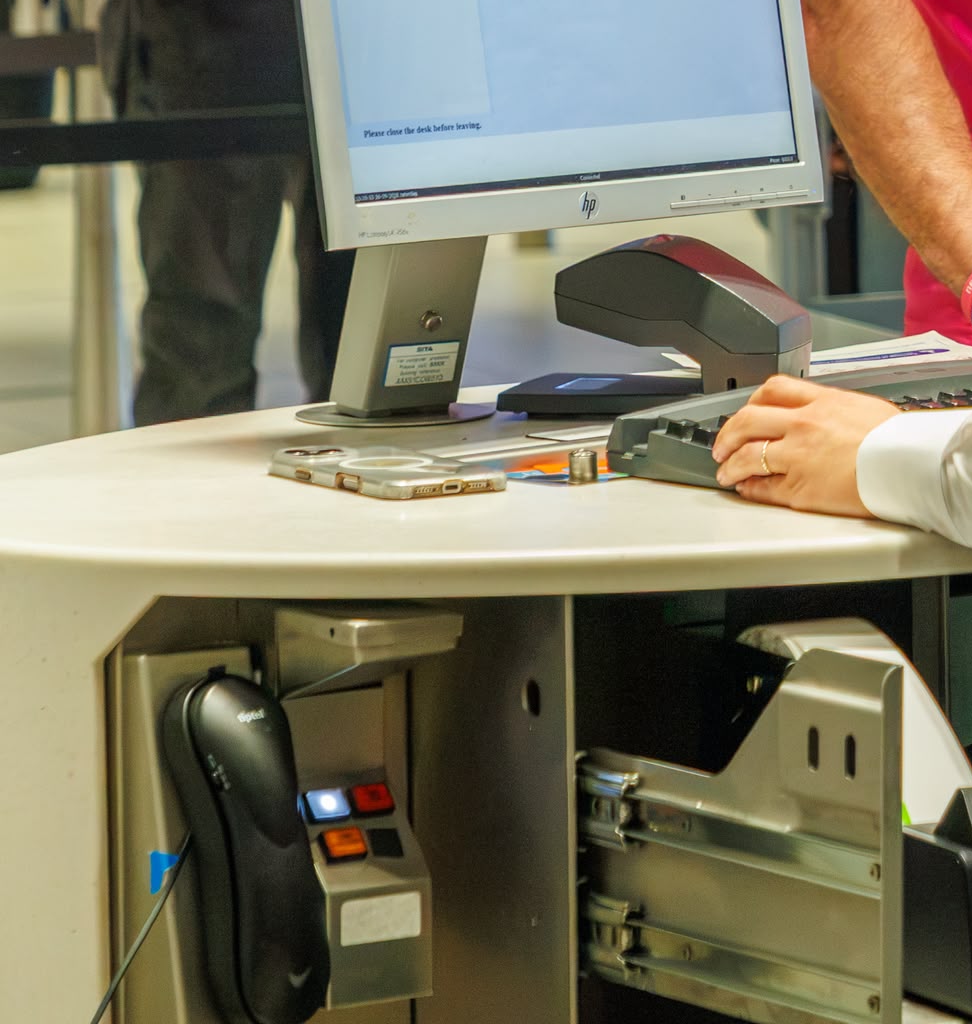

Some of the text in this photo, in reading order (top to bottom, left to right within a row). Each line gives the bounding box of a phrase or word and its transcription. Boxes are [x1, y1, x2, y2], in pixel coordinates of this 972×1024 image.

[363, 121, 482, 138] Please close the desk before leaving.
[582, 191, 597, 219] hp
